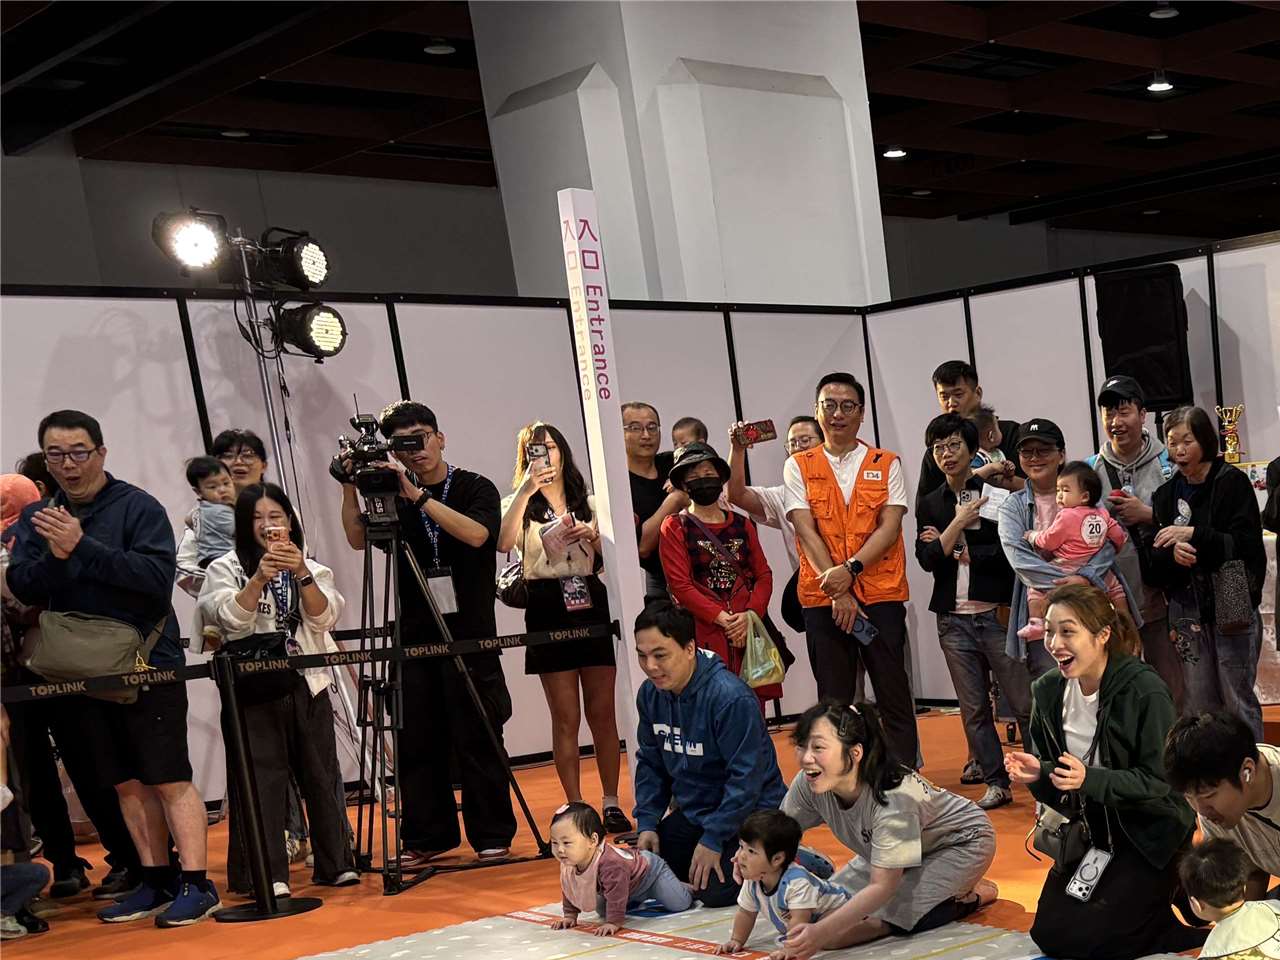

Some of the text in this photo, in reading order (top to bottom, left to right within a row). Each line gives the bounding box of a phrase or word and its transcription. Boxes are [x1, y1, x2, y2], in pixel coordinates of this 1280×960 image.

[578, 219, 612, 401] 入口 Entrance
[1088, 523, 1102, 534] 20
[238, 627, 590, 673] TOPLINK TOPLINK TOPLINK TOPLINK TOPLINK
[30, 670, 177, 697] TOPLINK TOPLINK
